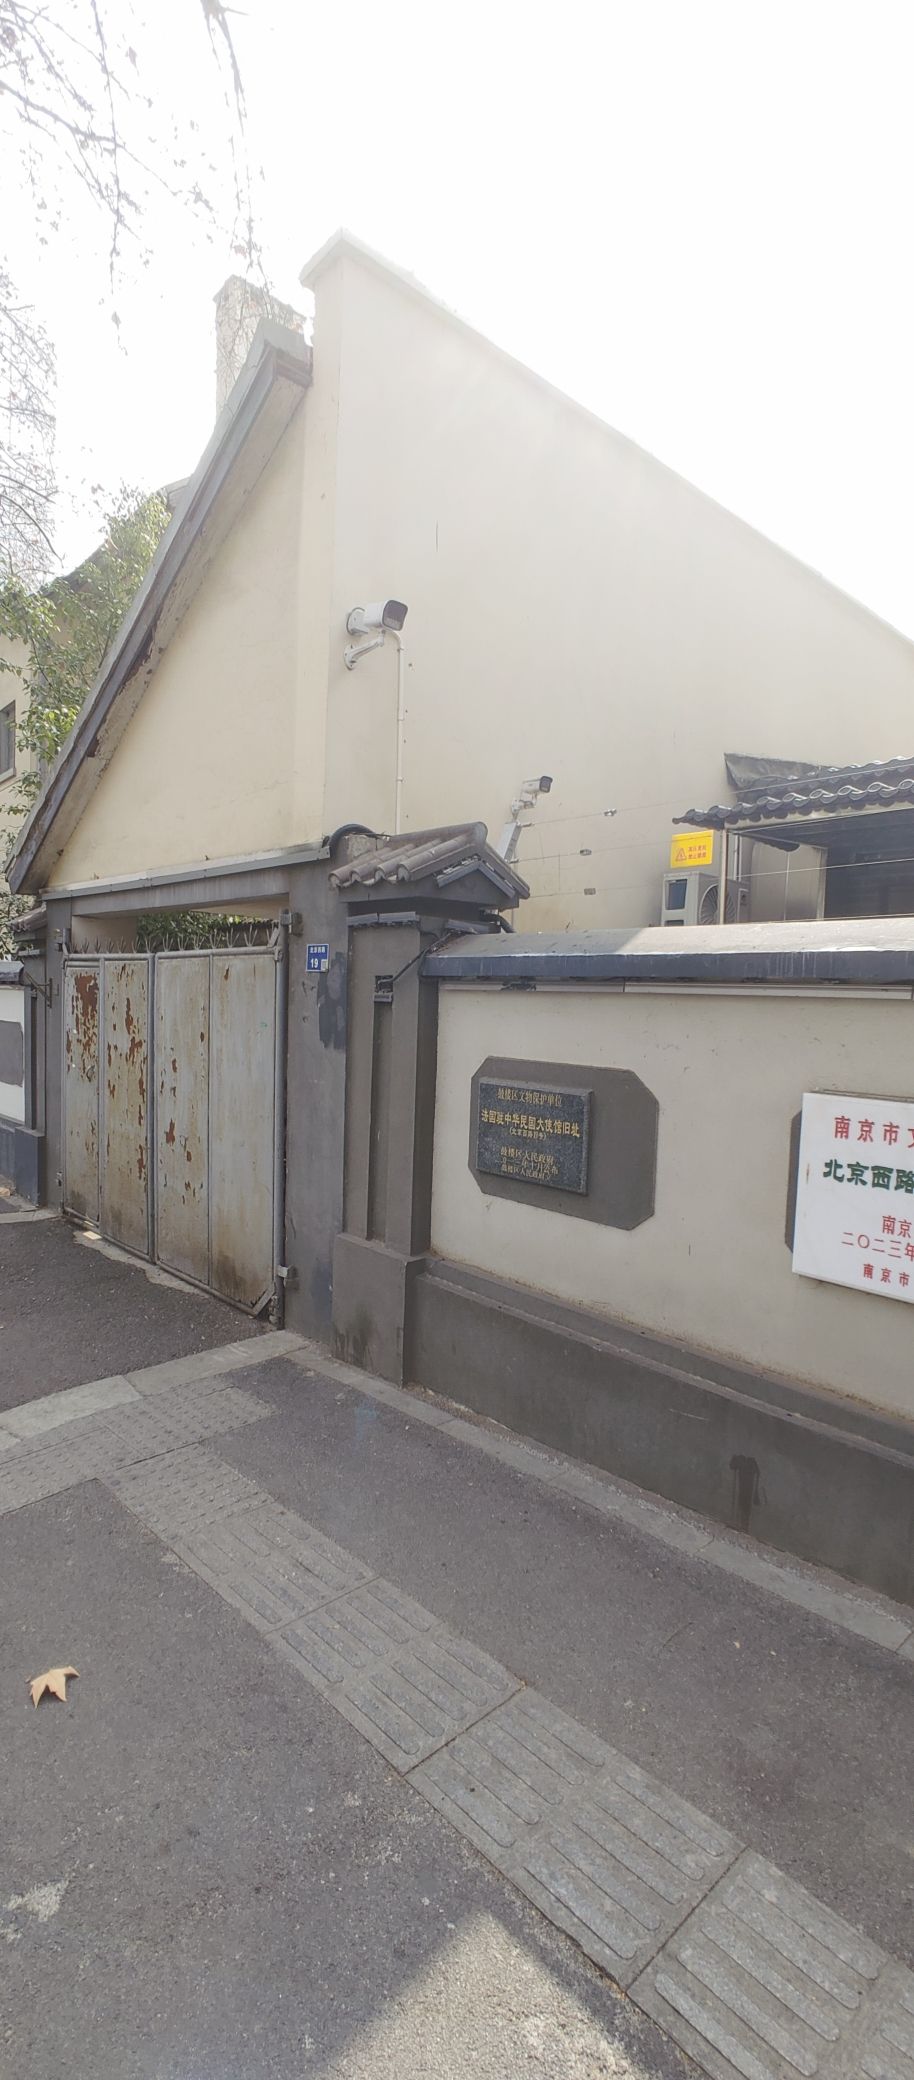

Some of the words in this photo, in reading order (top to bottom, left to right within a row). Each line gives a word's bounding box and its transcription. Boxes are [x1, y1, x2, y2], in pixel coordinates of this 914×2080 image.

[311, 958, 319, 968] 19
[497, 1087, 562, 1107] 鼓楼区文物保护单位
[481, 1109, 580, 1138] 法国驻中华民国大使馆旧址
[500, 1146, 554, 1166] 鼓楼区人民政府
[823, 1159, 914, 1194] 北京西路
[882, 1215, 912, 1239] 南京
[863, 1263, 910, 1288] 南京市
